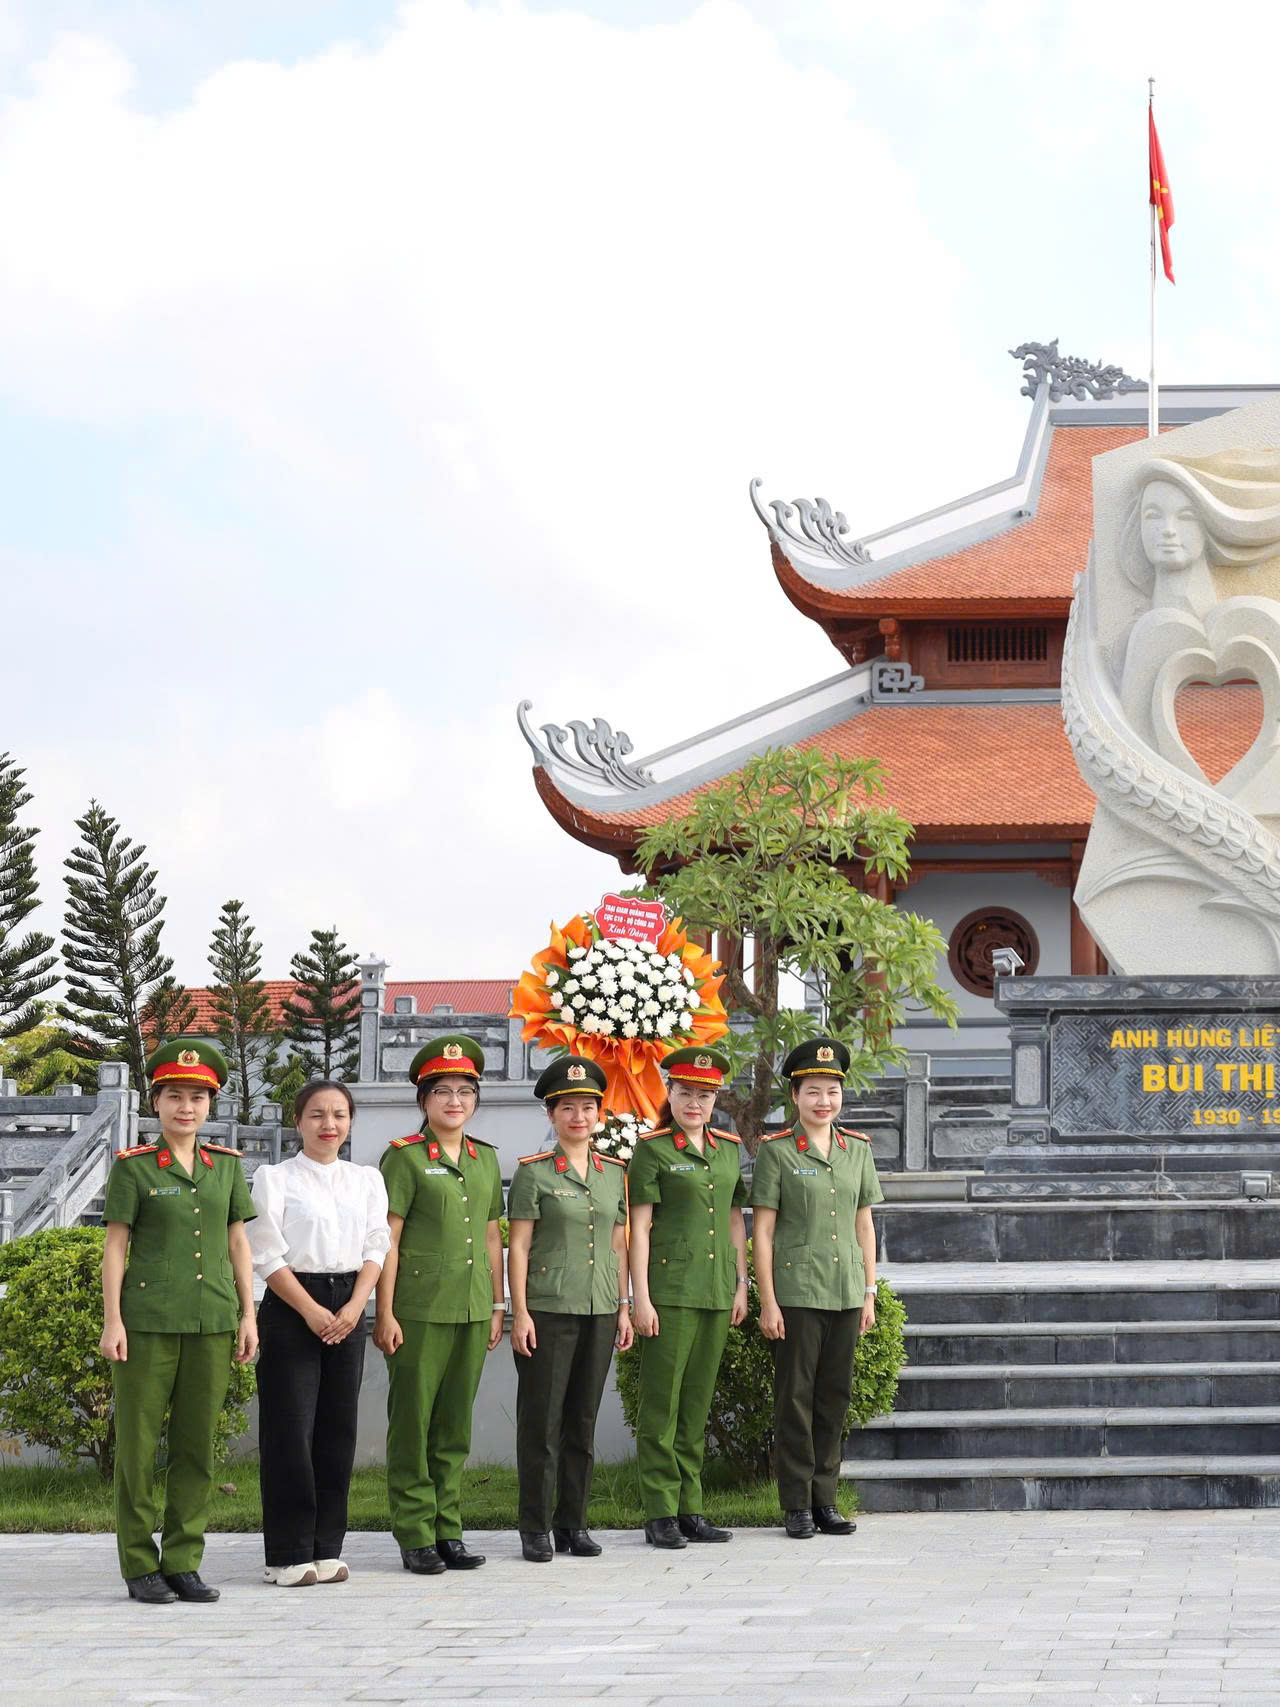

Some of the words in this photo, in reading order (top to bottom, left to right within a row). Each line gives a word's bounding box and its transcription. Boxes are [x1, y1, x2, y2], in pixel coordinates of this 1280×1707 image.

[1110, 1029, 1158, 1048] ANH
[1167, 1024, 1232, 1048] HÙNG
[1142, 1056, 1203, 1093] BÙI
[1216, 1063, 1274, 1099] THỊ
[1194, 1110, 1240, 1126] 1930
